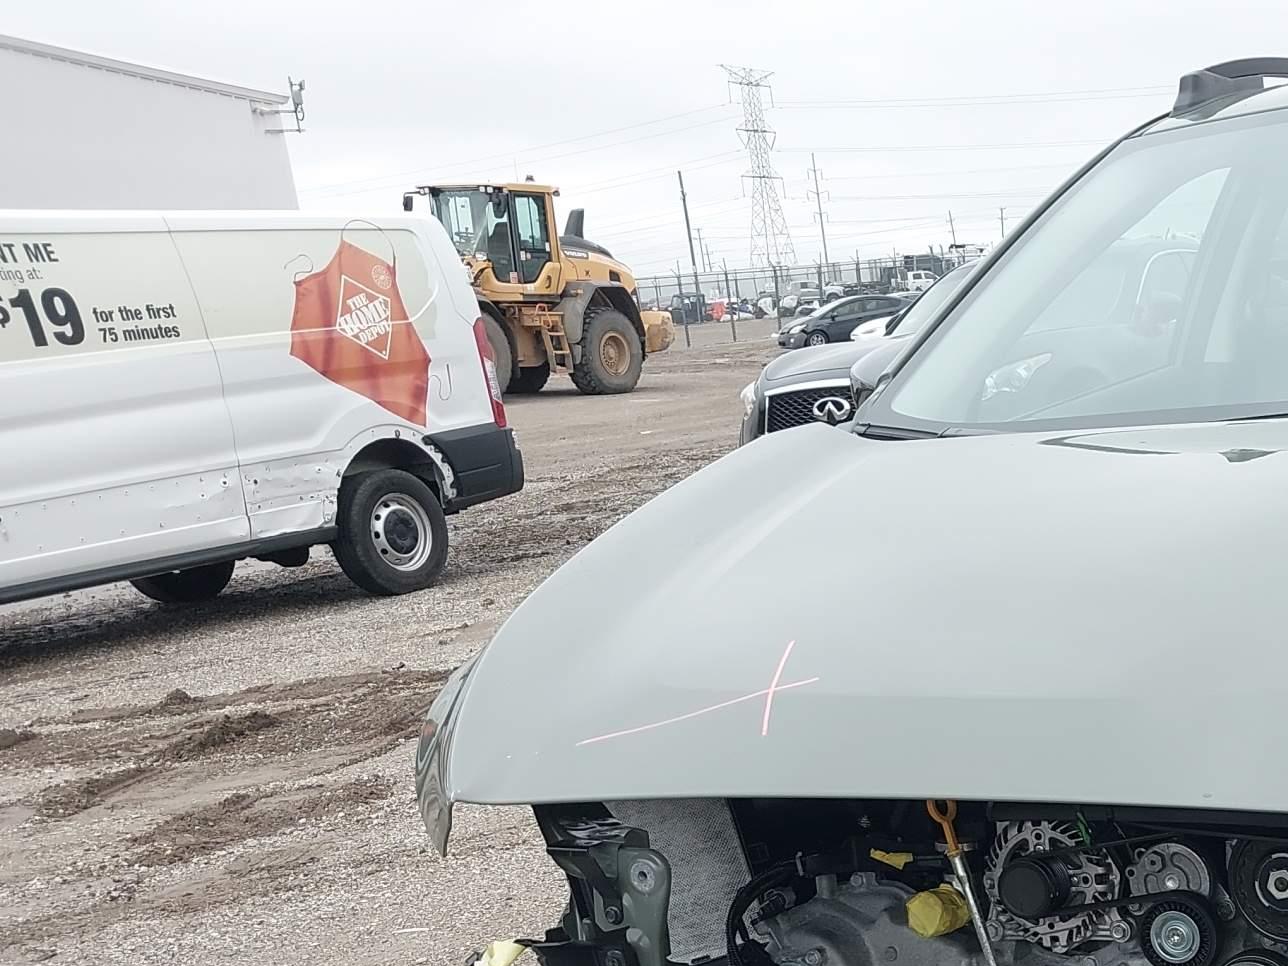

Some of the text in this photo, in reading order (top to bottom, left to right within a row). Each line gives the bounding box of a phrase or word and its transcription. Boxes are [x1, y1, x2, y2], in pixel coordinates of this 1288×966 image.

[22, 242, 59, 263] ME
[26, 267, 43, 280] at:
[345, 293, 370, 311] THE
[92, 303, 177, 323] for the first
[340, 297, 389, 336] HOME
[98, 324, 181, 343] 75 minutes
[358, 319, 391, 344] DEPOT
